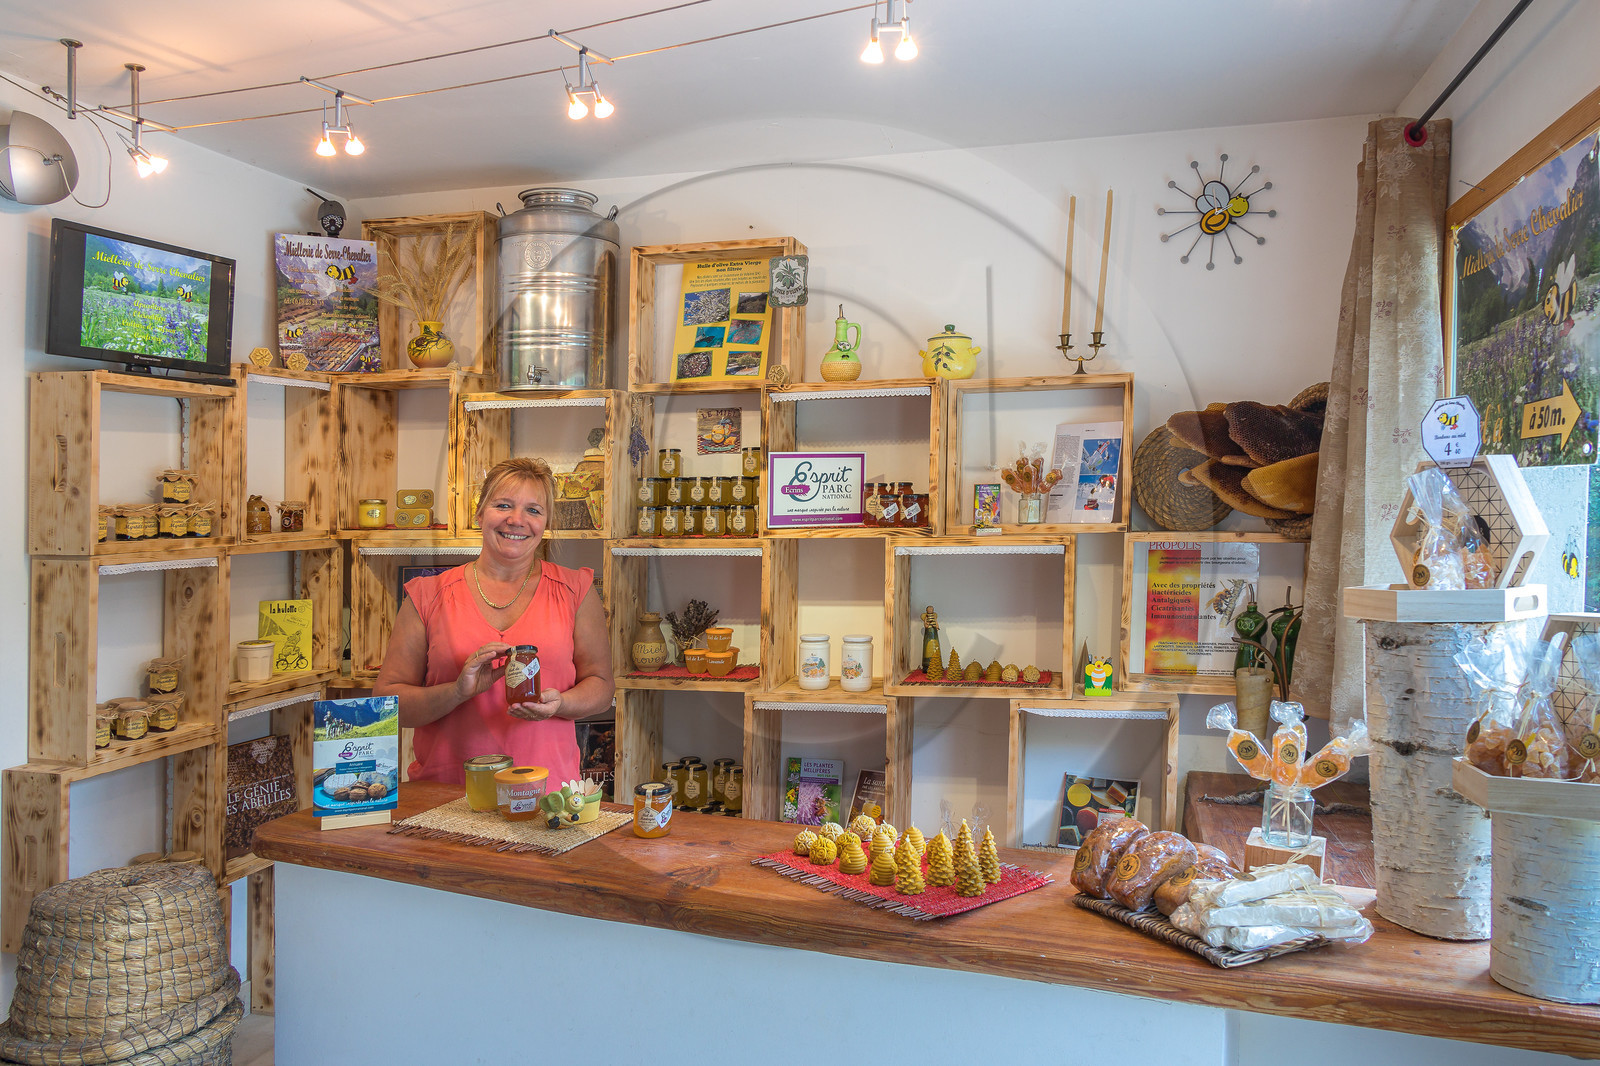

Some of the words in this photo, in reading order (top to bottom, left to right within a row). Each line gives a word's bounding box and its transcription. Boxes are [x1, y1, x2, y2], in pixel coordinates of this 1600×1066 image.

[1503, 228, 1530, 253] Serre
[1530, 187, 1583, 236] Chevalier
[284, 241, 314, 258] Miellerie
[315, 246, 323, 258] de
[92, 251, 132, 267] Miellerie
[134, 259, 145, 270] de
[147, 262, 167, 275] Serre
[169, 267, 206, 283] Chevalier
[701, 410, 714, 419] LE
[716, 409, 737, 418] MIEL
[1444, 442, 1452, 456] 4
[822, 484, 853, 494] PARC
[1149, 541, 1202, 550] PROPOLIS
[1181, 582, 1216, 591] propriétés
[1151, 597, 1192, 605] Antalgiques
[1151, 604, 1195, 612] Cicatrisantes
[636, 643, 665, 655] Miel
[227, 792, 240, 805] LE
[243, 780, 281, 799] GÉNIE
[507, 788, 541, 797] Montagne
[226, 803, 238, 816] ES
[241, 788, 292, 812] ABEILLES
